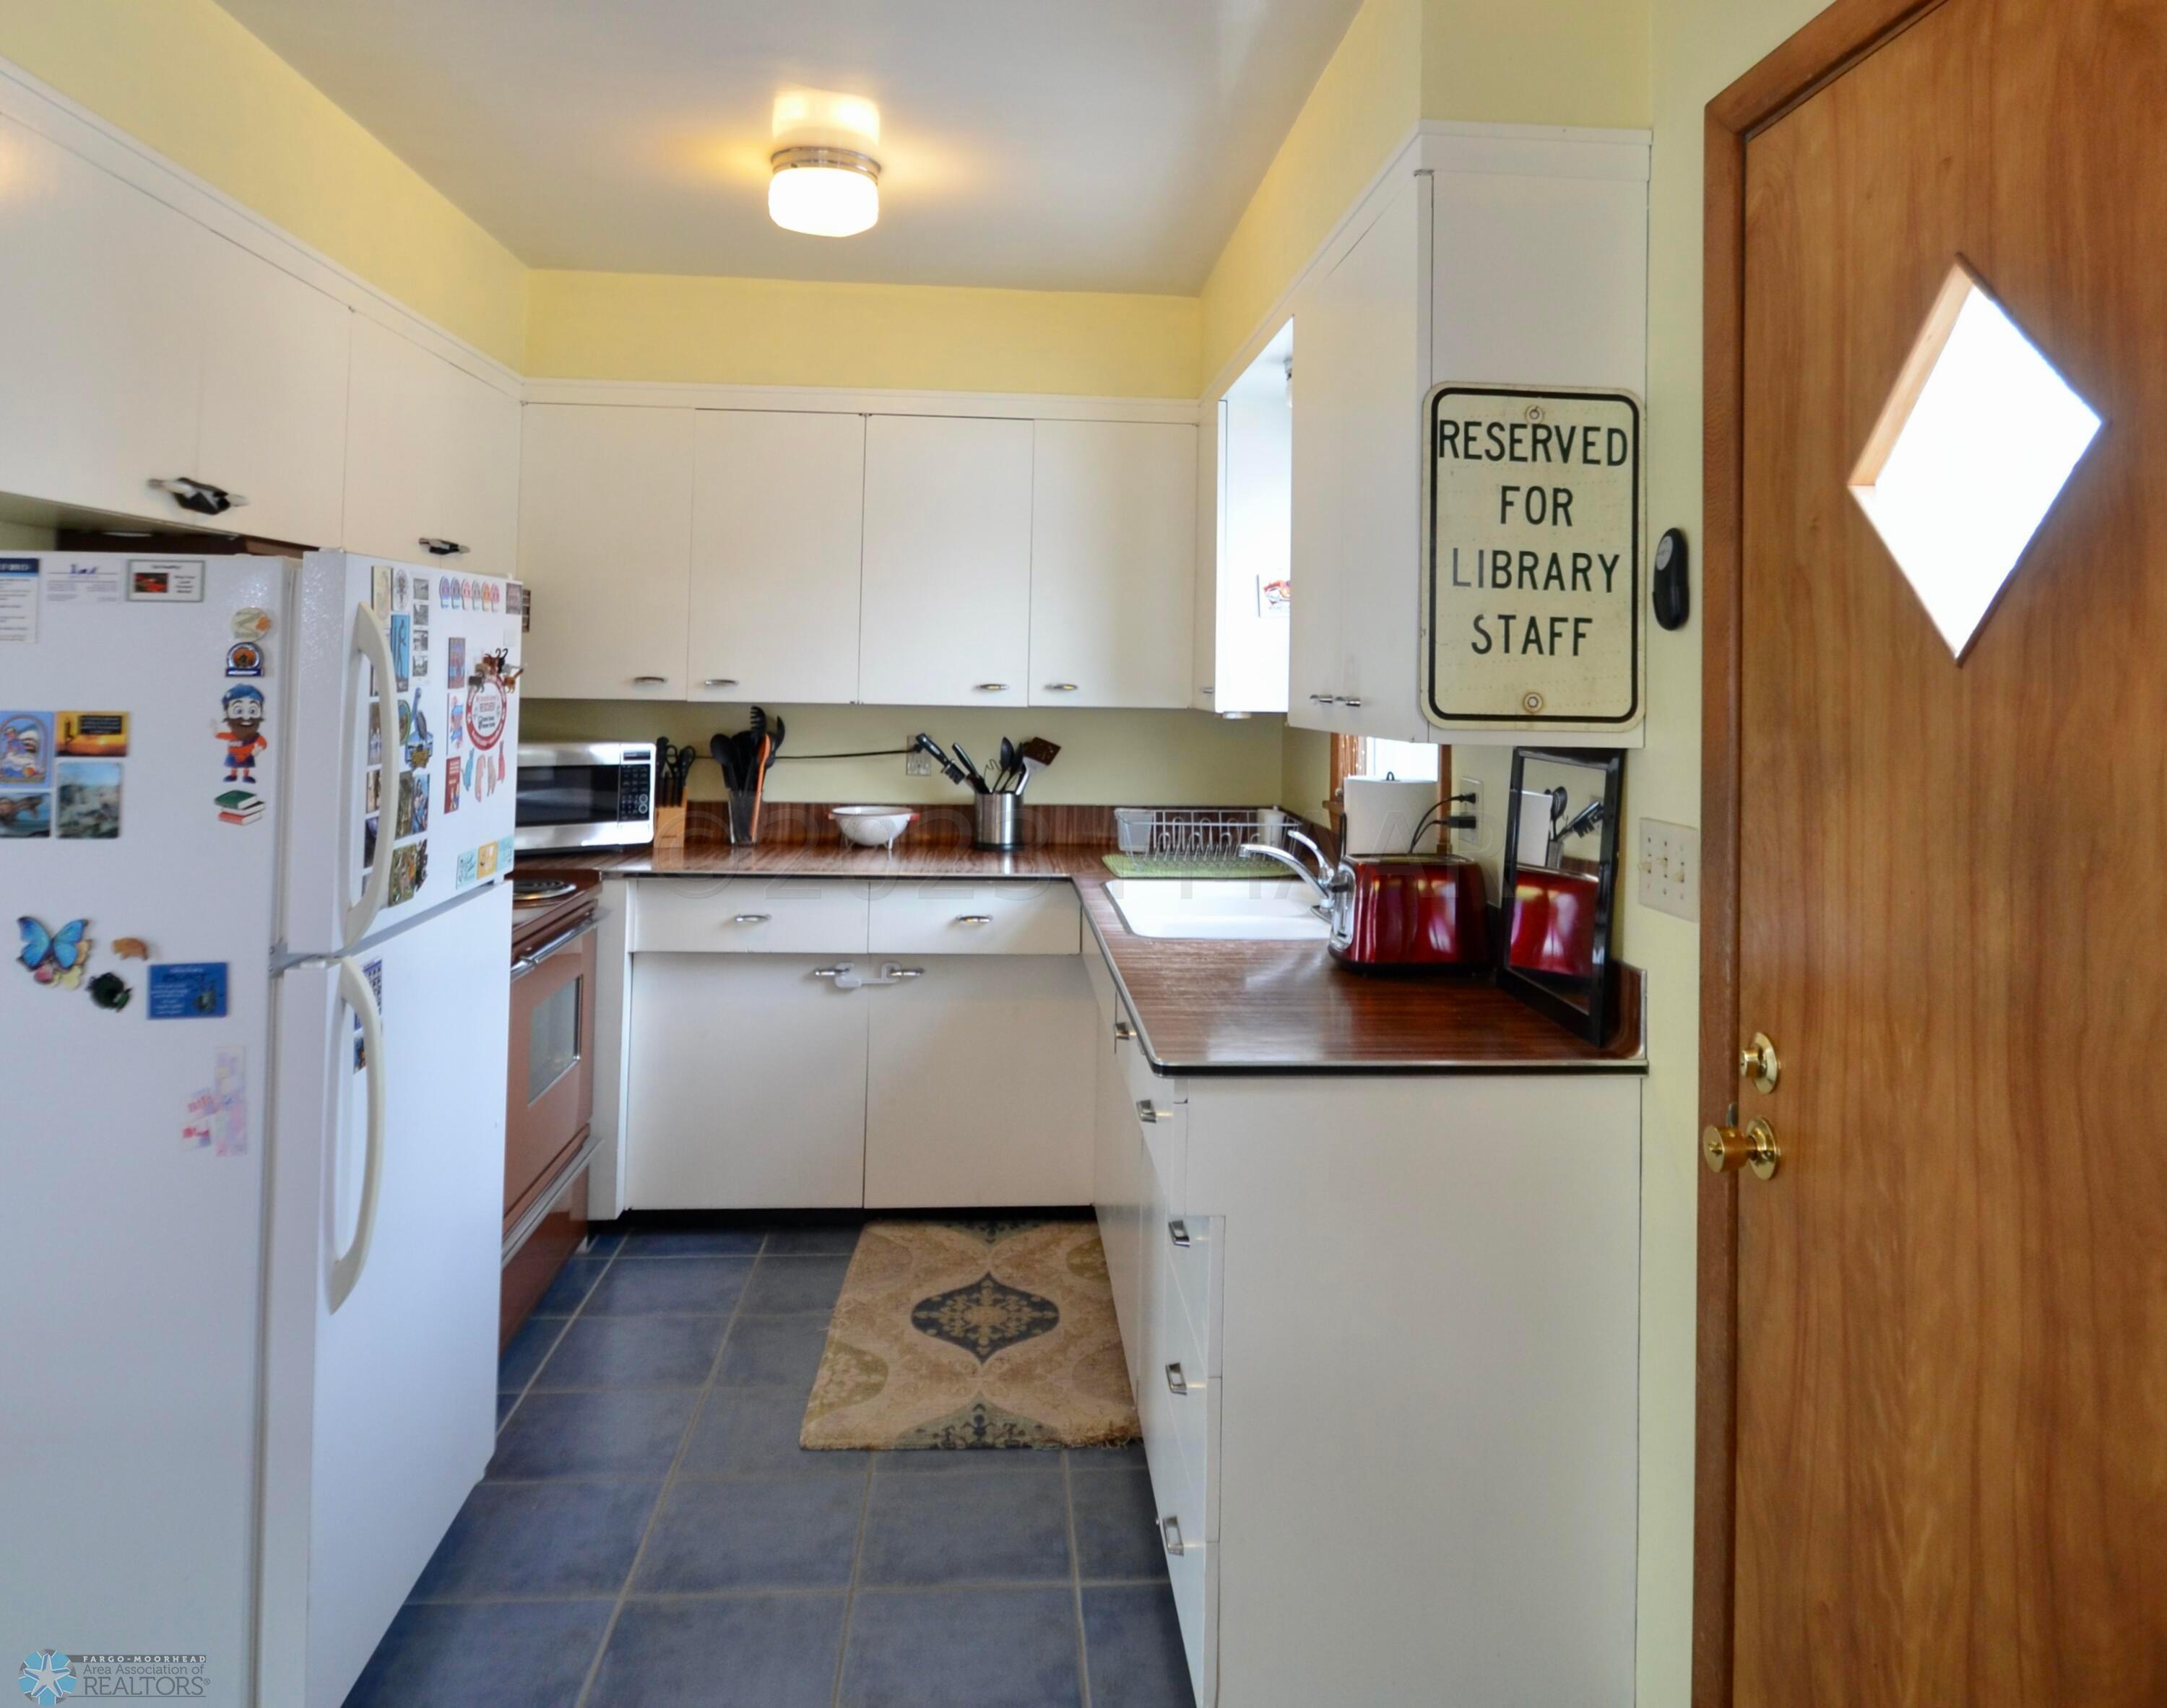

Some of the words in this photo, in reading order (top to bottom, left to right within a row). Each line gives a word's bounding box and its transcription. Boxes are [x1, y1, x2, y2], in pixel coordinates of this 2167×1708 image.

[1438, 420, 1628, 467] RESERVED
[1500, 485, 1573, 526] FOR
[1452, 547, 1620, 594] LIBRARY
[1471, 614, 1593, 656] STAFF
